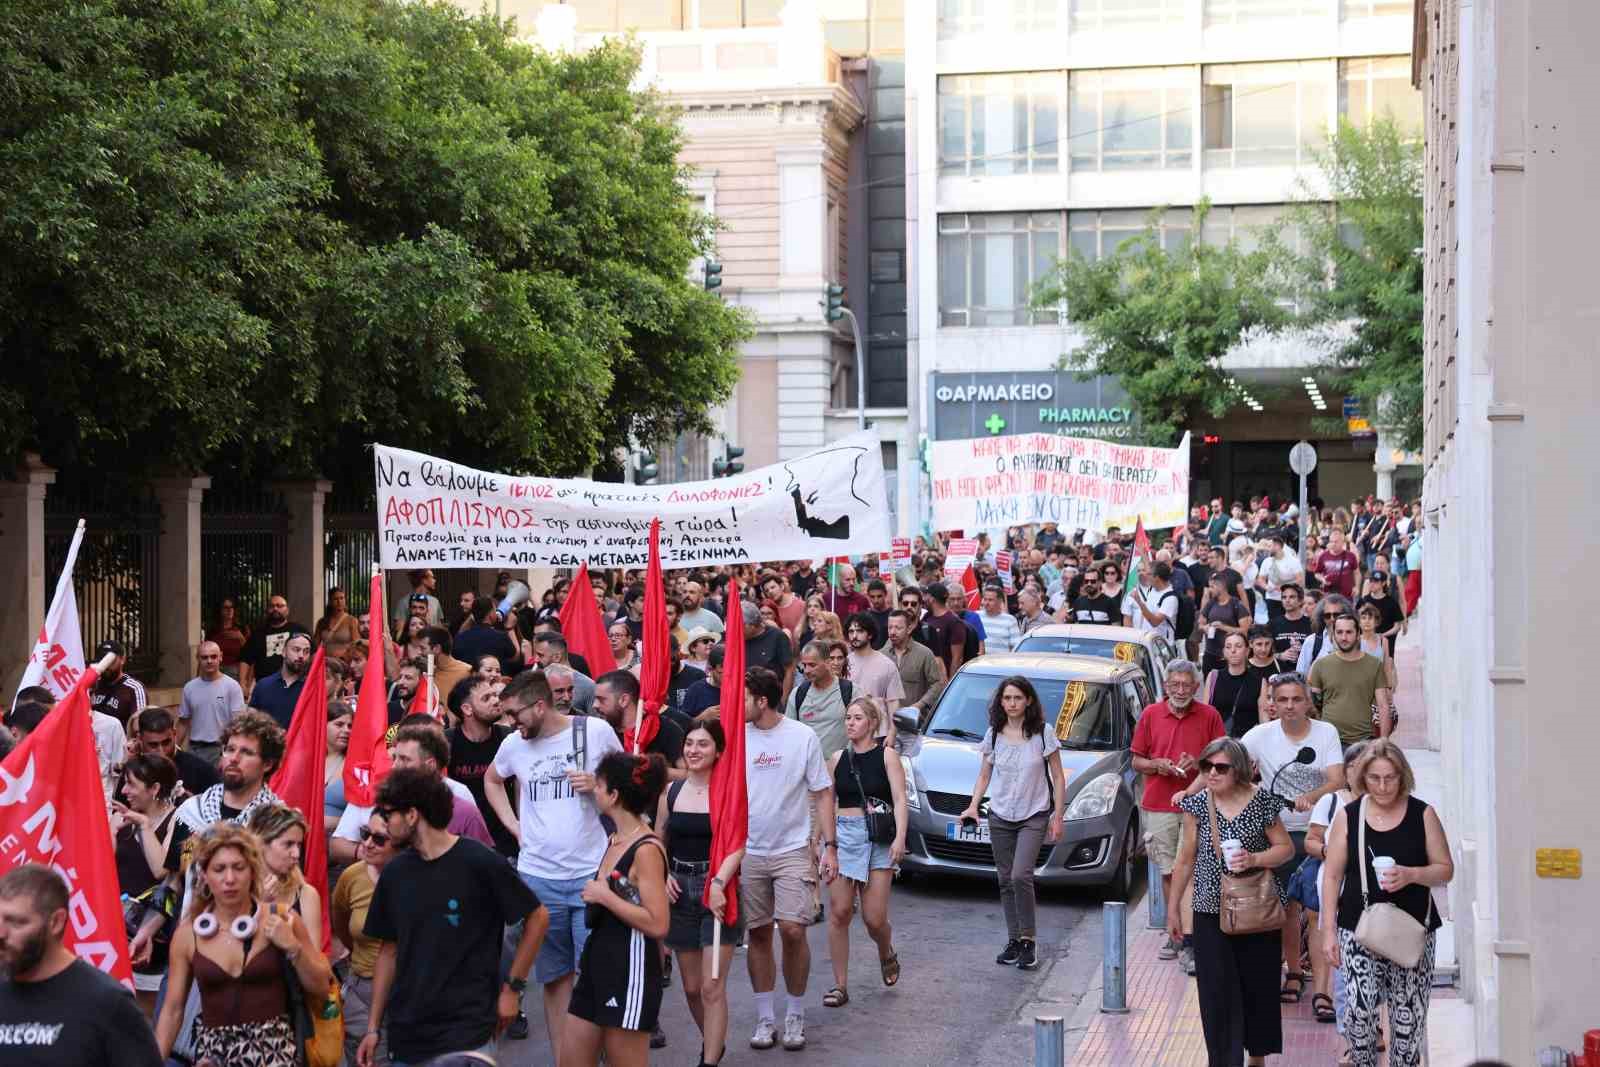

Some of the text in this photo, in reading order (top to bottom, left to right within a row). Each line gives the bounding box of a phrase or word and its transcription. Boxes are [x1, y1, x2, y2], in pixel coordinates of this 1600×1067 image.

[936, 384, 1053, 402] ΦΑΡΜΑΚΕΙΟ
[1039, 407, 1132, 422] PHARMACY
[377, 456, 411, 488] Να
[421, 461, 499, 497] βάλουμε
[385, 496, 539, 528] ΑΦΟΠΛΙΣΜΟΣ
[542, 518, 569, 534] της
[474, 535, 491, 545] για
[606, 534, 673, 549] ανατρεπκή
[588, 553, 648, 565] ΜΕΤΑΒΑΣ
